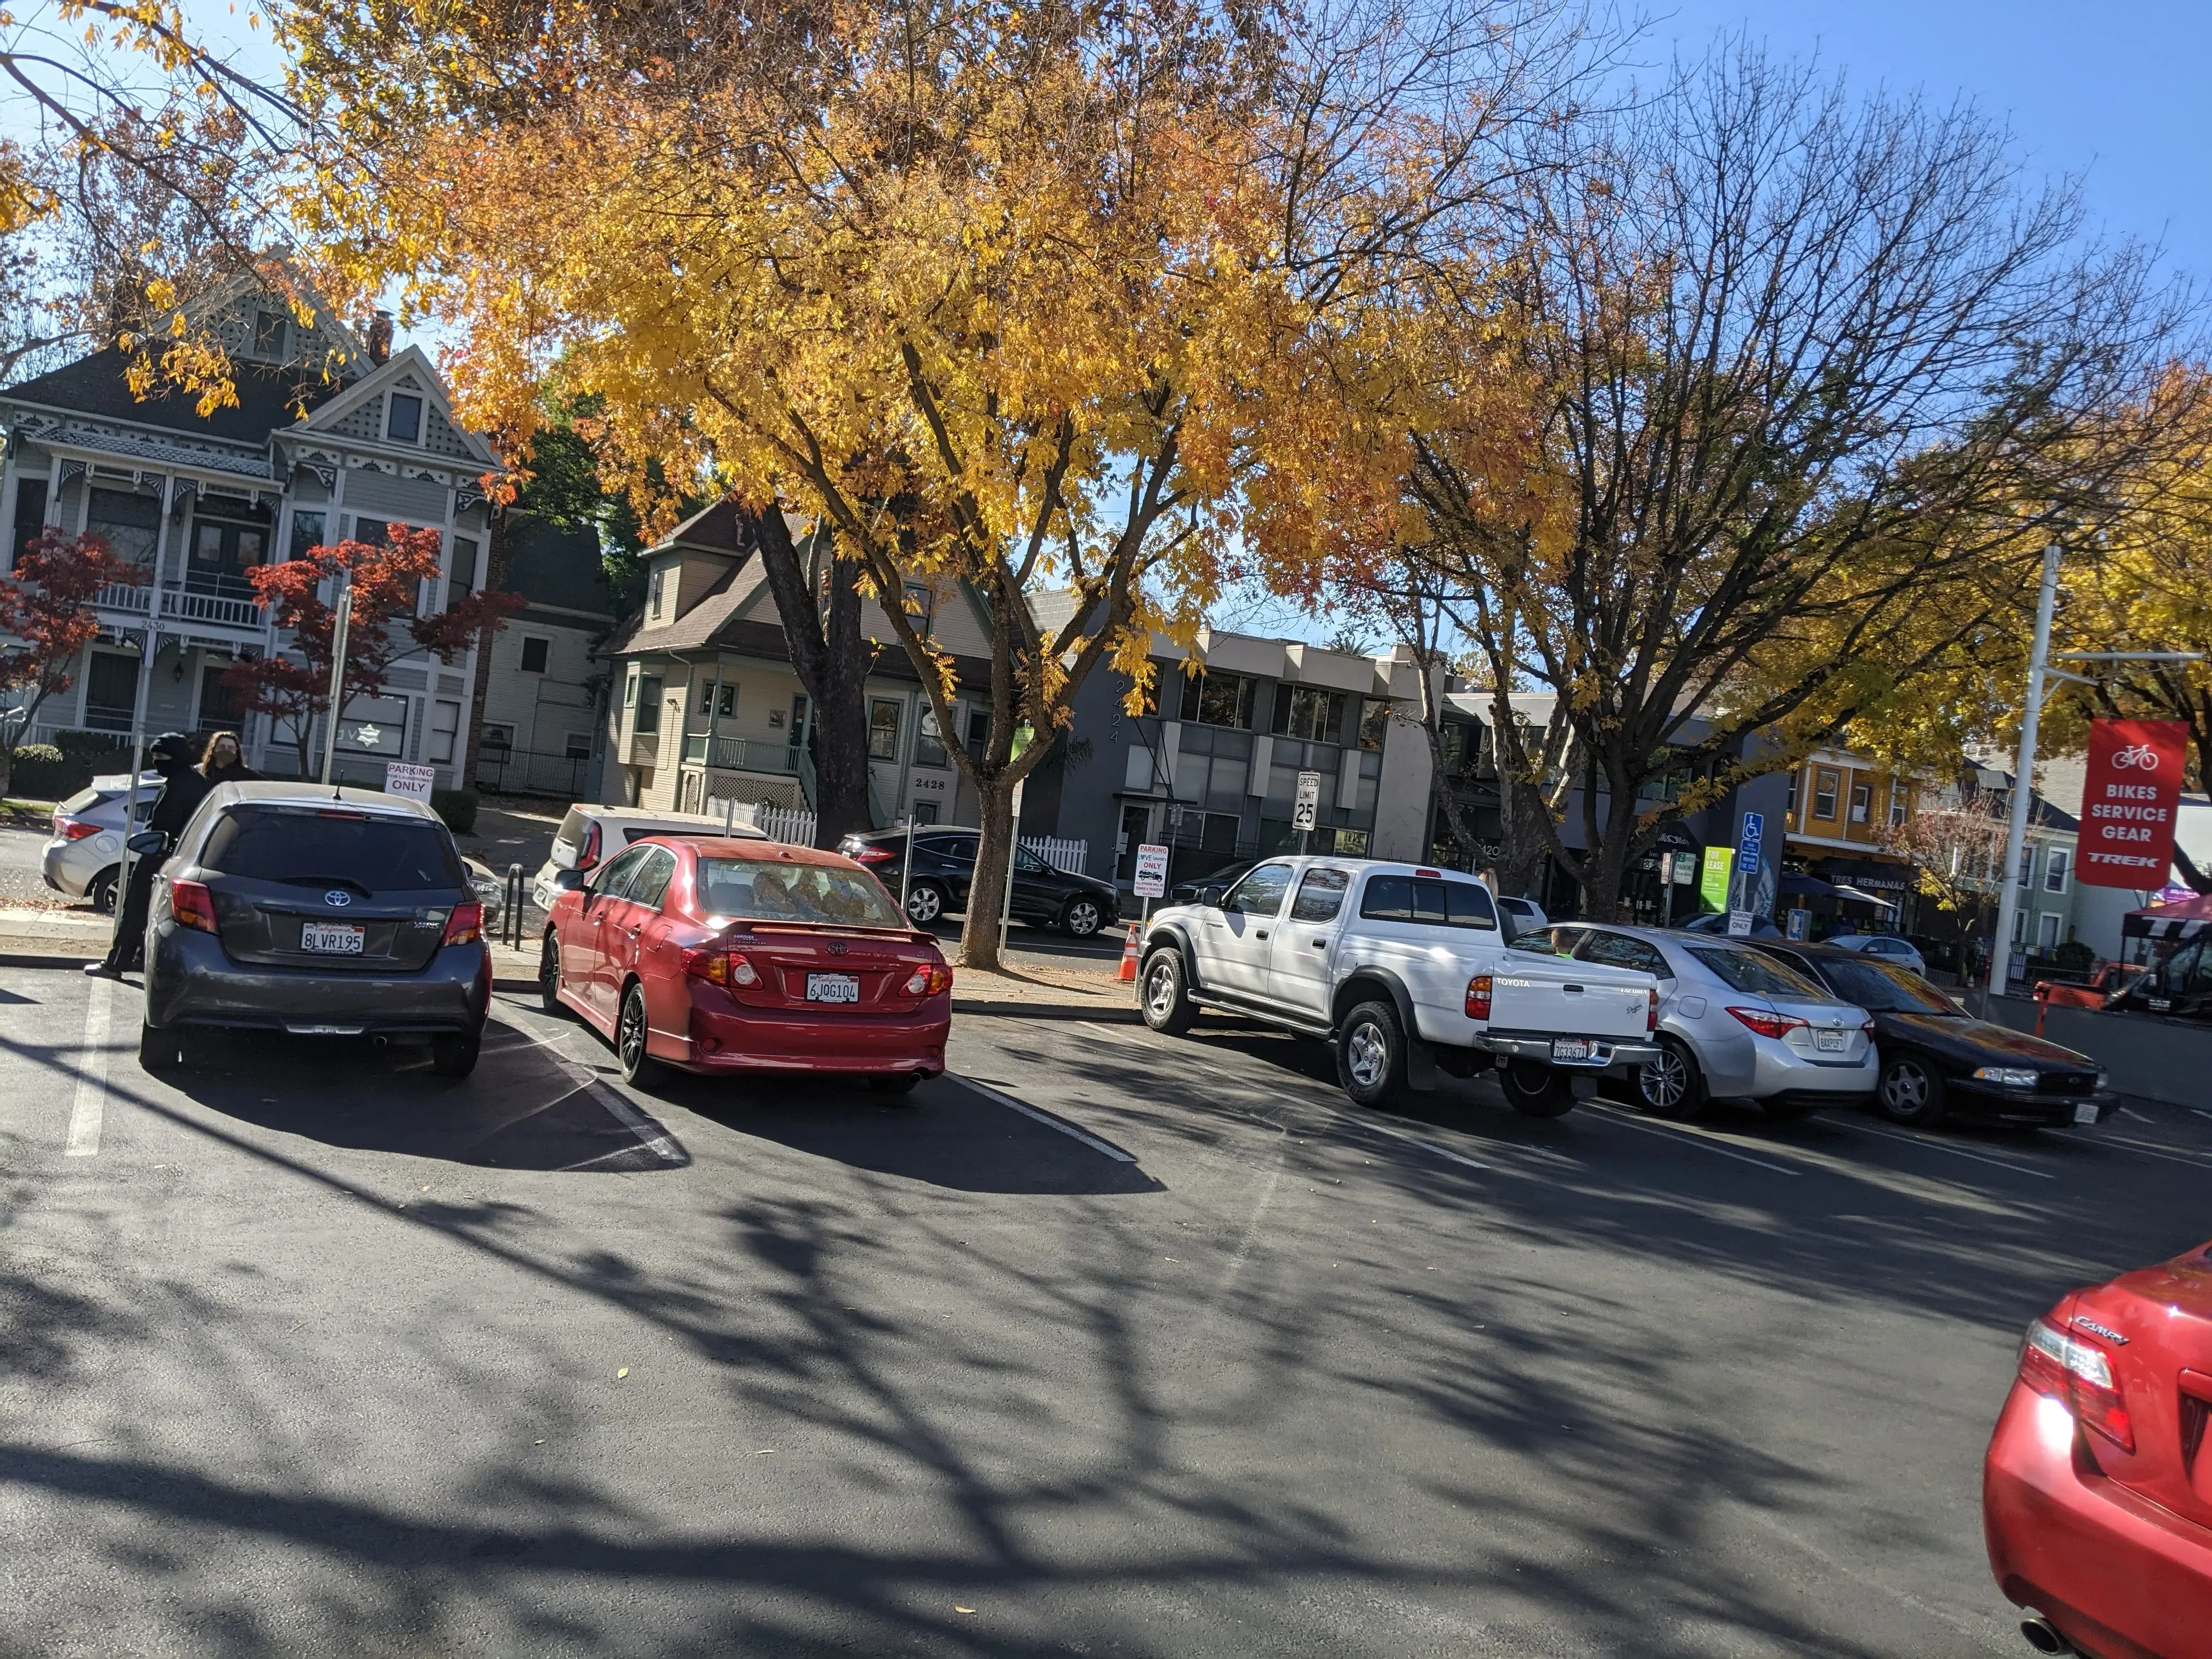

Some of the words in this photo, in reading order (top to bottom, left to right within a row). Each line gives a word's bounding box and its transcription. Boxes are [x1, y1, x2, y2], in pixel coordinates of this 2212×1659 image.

[141, 620, 165, 631] 2430
[1110, 680, 1125, 743] 2424
[388, 764, 433, 777] PARKING
[392, 780, 425, 792] ONLY
[915, 778, 944, 789] 2428
[1299, 778, 1318, 787] SPEED
[1299, 790, 1314, 799] LIMIT
[2106, 784, 2157, 800] BIKES
[1296, 803, 1313, 823] 25
[2091, 804, 2166, 822] SERVICE
[2102, 826, 2152, 842] GEAR
[1707, 850, 1719, 859] FOR
[2087, 852, 2160, 868] TREK
[1706, 861, 1724, 870] LEASE
[1830, 874, 1853, 884] TRES
[1857, 877, 1905, 890] HERMANAS
[304, 933, 360, 950] 8LVR195
[818, 975, 850, 984] California
[1496, 978, 1530, 988] TOYOTA
[810, 983, 855, 998] 6JQG104
[1556, 1046, 1584, 1058] 7G33671
[2075, 1316, 2129, 1345] CAMRY
